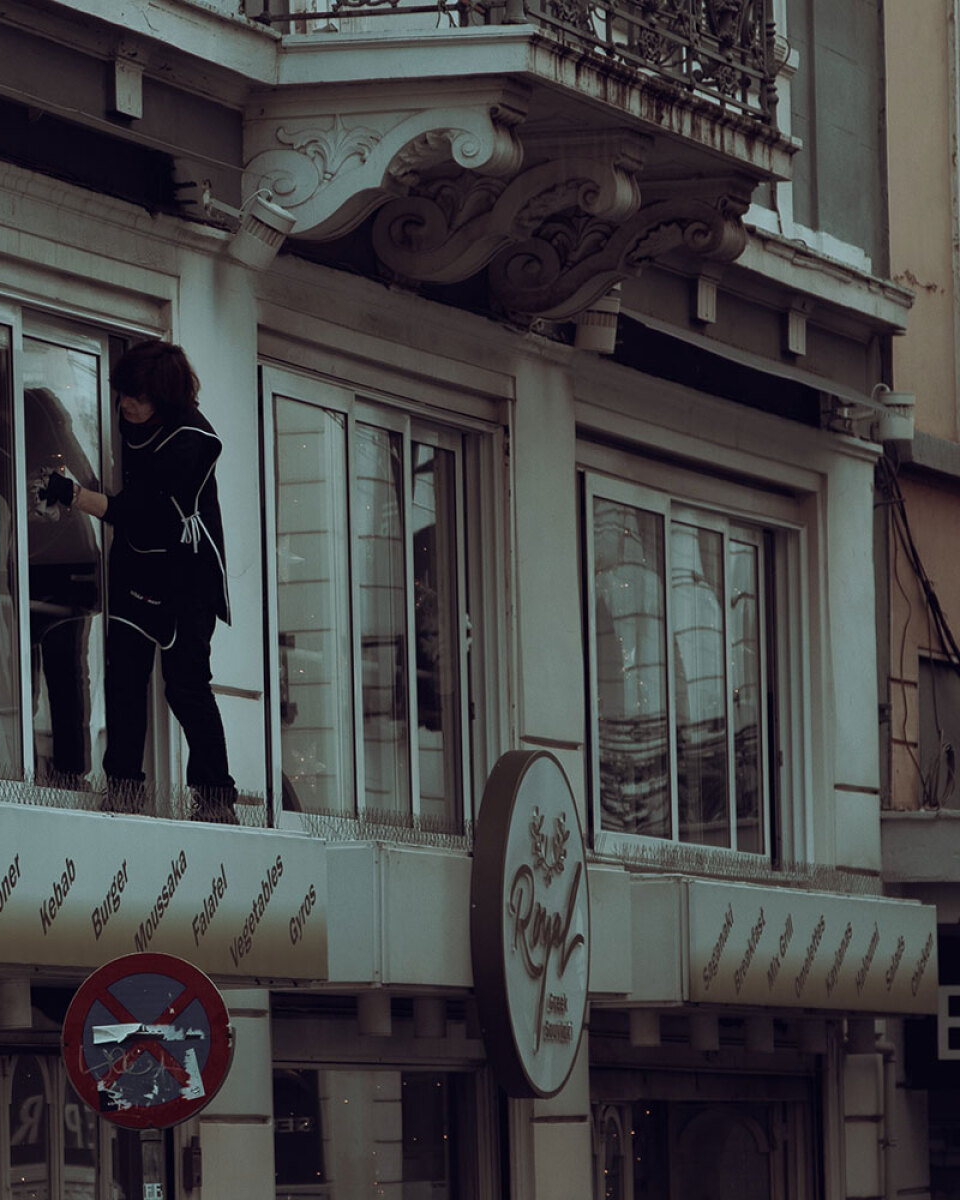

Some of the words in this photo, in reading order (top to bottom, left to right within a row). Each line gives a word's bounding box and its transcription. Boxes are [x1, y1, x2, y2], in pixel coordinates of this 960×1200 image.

[39, 857, 76, 935] Kebab
[91, 858, 129, 940] Burger
[133, 849, 188, 952] Moussaka
[191, 863, 228, 947] Falafel
[229, 854, 284, 968] Vegetables
[288, 884, 317, 945] Gyros
